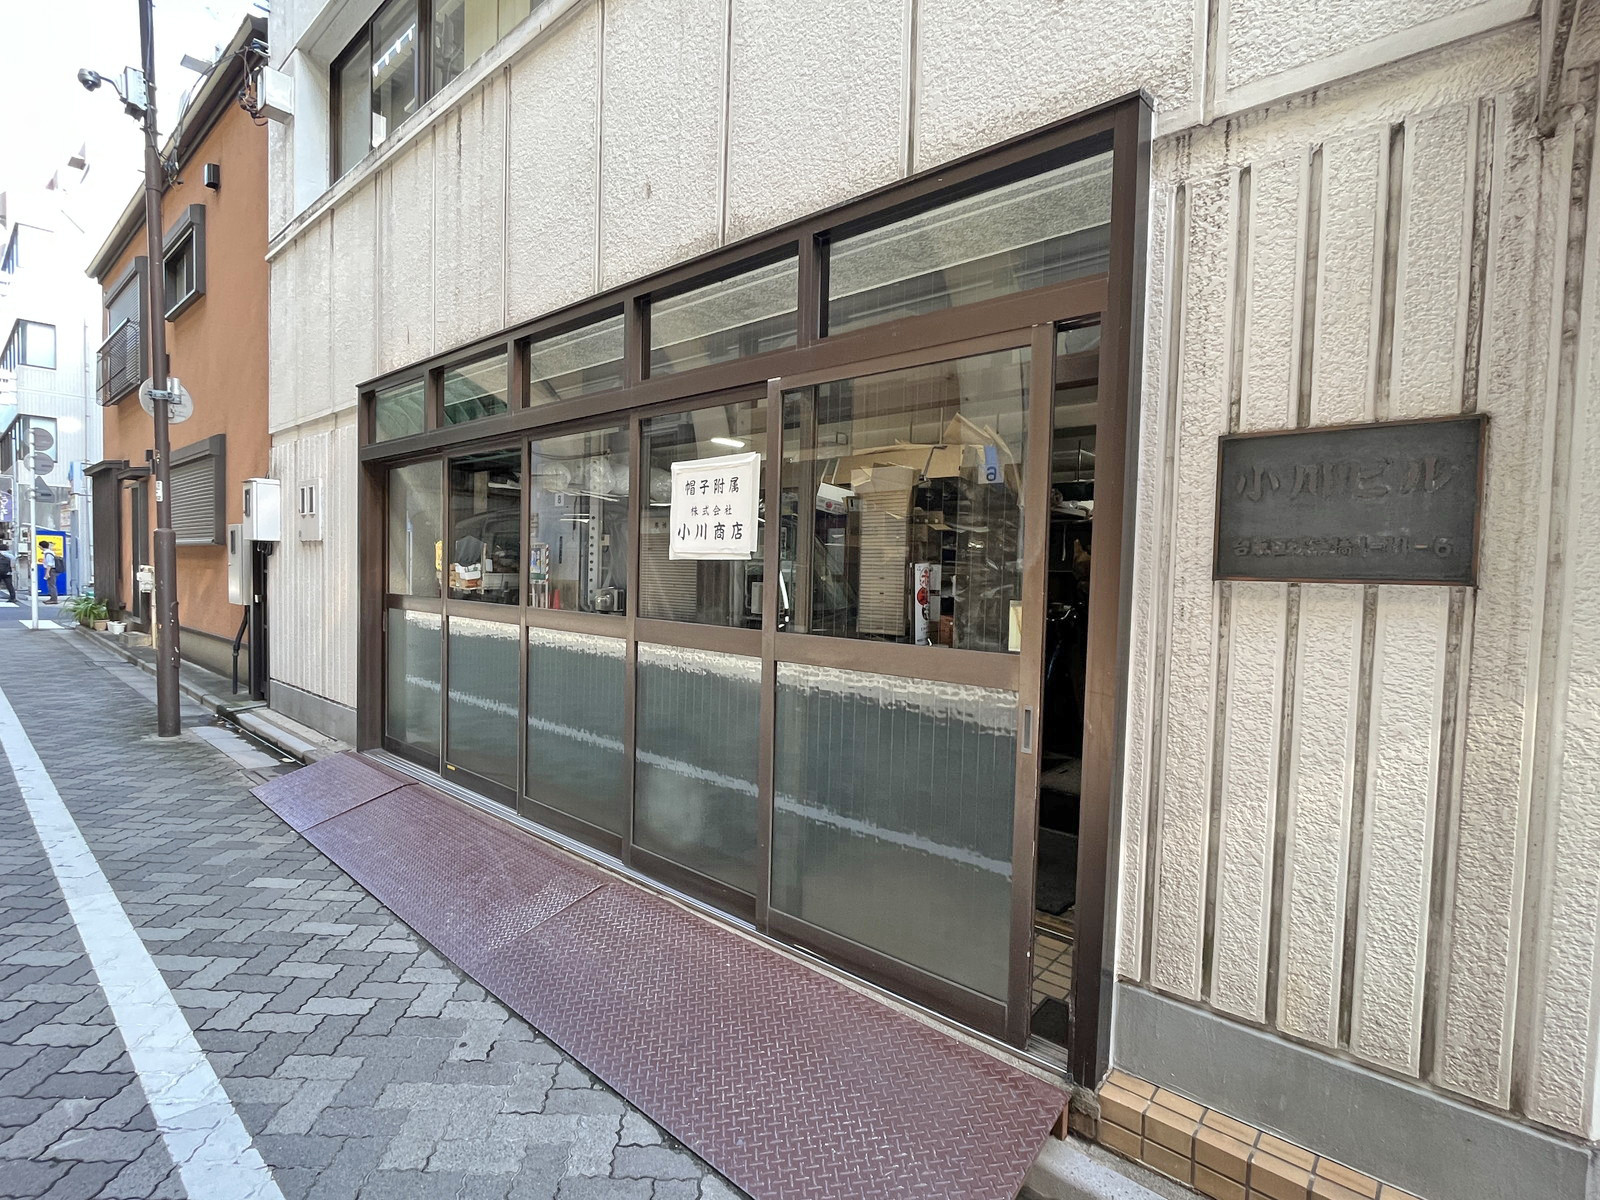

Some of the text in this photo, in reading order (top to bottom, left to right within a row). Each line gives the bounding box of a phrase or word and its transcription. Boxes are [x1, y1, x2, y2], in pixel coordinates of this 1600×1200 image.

[685, 477, 740, 496] 帽子附属
[1236, 455, 1464, 502] 小川ビル
[691, 504, 733, 517] 株式会社
[677, 521, 744, 541] 小川商店
